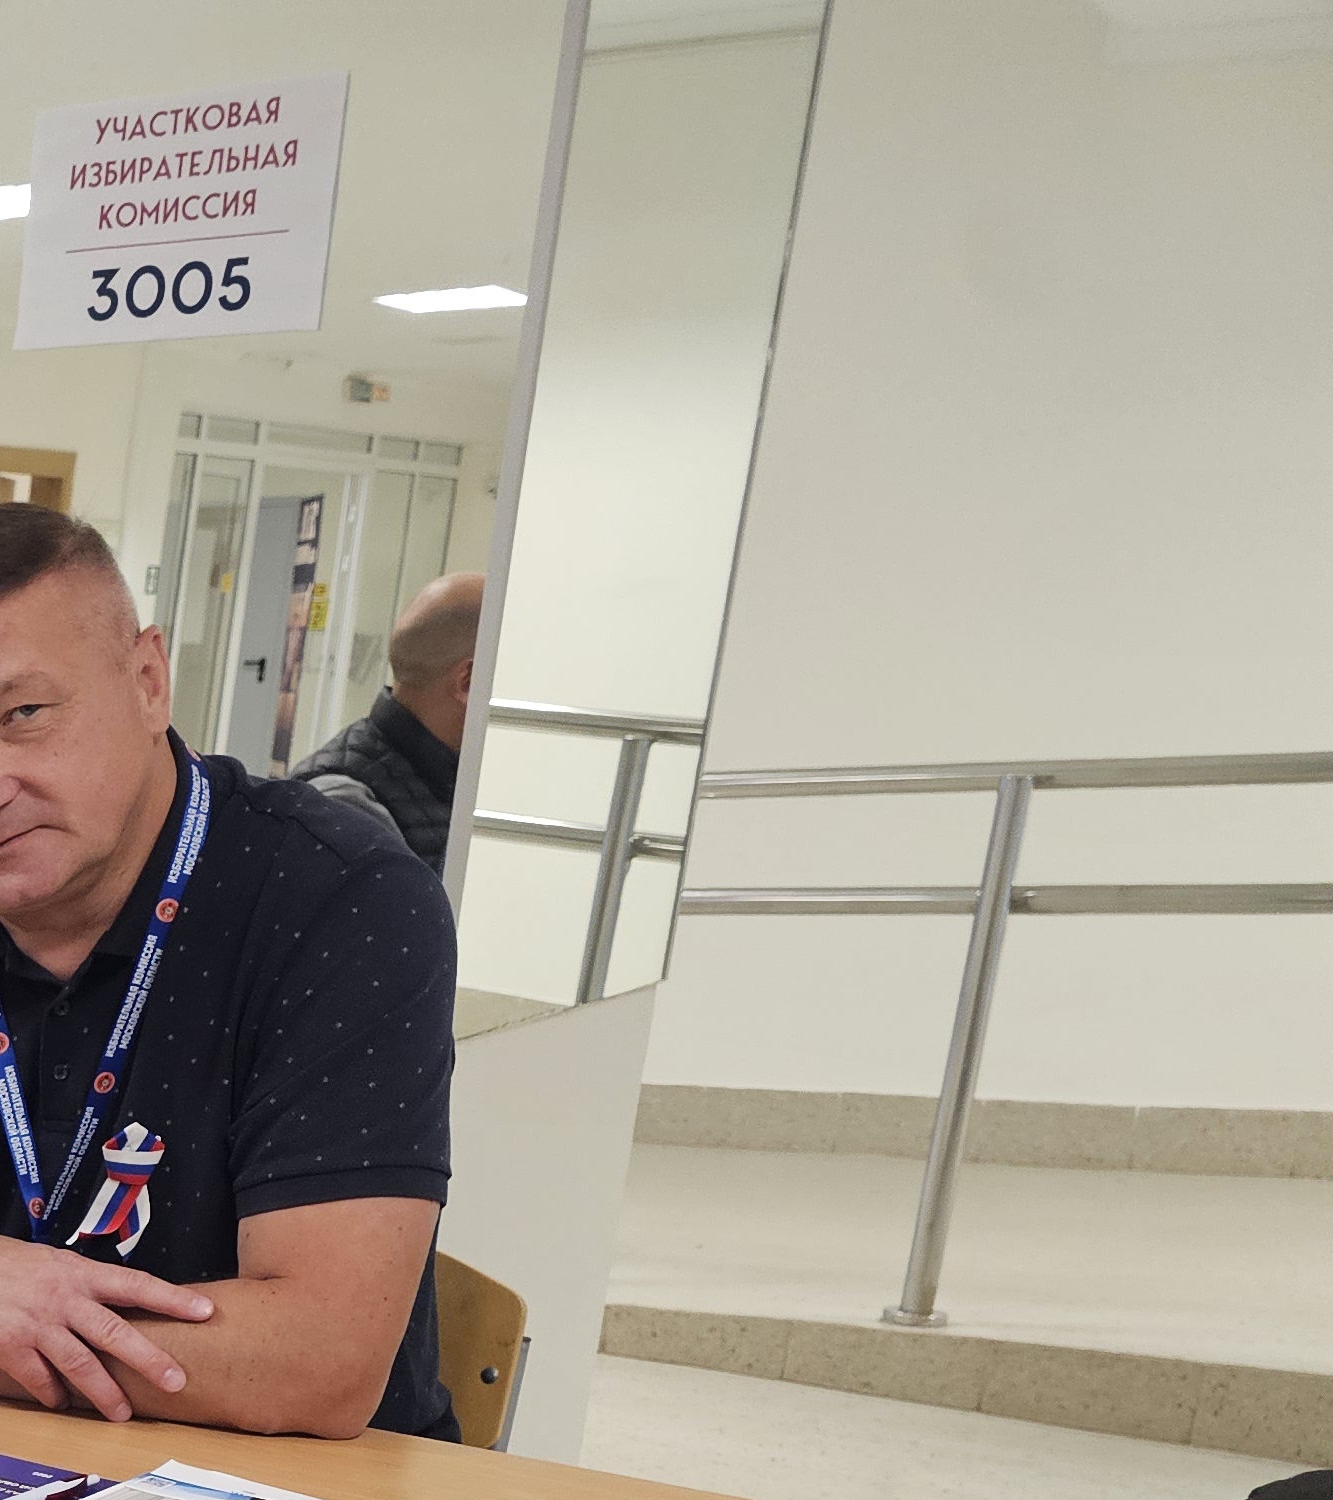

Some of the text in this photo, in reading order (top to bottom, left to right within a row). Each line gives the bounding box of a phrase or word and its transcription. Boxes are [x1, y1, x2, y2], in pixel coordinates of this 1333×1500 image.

[95, 96, 281, 145] УЧАСТКОВАЯ
[69, 139, 299, 191] ИЗБИРАТЕЛЬНАЯ
[98, 188, 257, 231] КОМИССИЯ
[87, 256, 251, 322] 3005
[166, 808, 197, 884] ИЗБИРАТЕЛЬНАЯ
[182, 813, 208, 876] МОСКОВСКОЙ
[105, 934, 159, 1058] ИЗБИРАТЕЛЬНАЯ КОМИССИЯ
[119, 948, 164, 1050] МОСКОВСКОЙ ОБЛАСТИ
[4, 1065, 40, 1185] ИЗБИРАТЕЛЬНАЯ КОМИССИЯ
[10, 1137, 28, 1176] ОБЛАСТИ
[42, 1106, 95, 1221] ИЗБИРАТЕЛЬНАЯ КОМИССИЯ
[52, 1117, 100, 1211] МОСКОВСКОЙ ОБЛАСТИ
